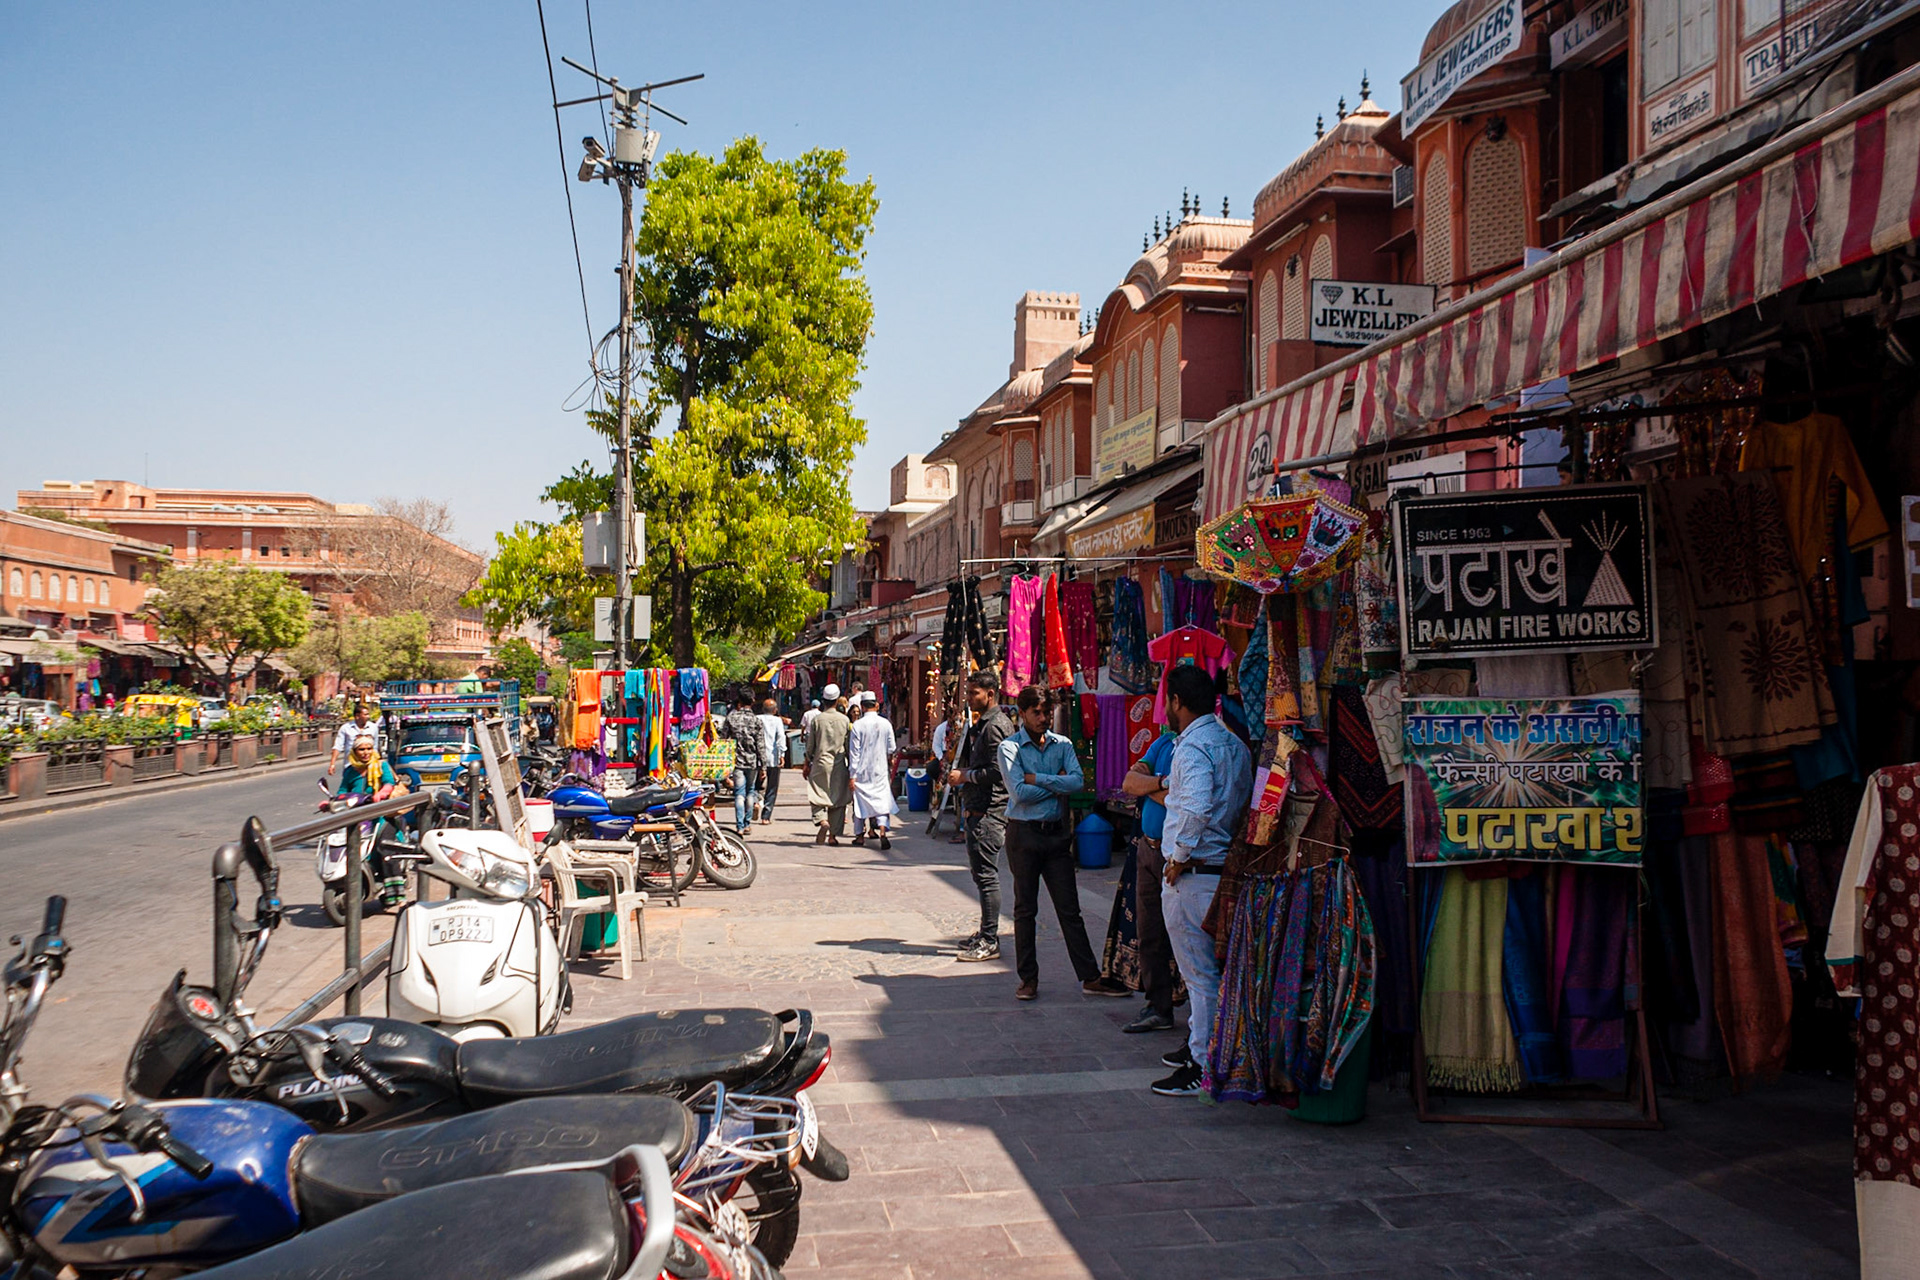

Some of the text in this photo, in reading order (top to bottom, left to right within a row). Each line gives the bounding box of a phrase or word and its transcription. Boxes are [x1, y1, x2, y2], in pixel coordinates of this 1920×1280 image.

[1406, 0, 1515, 111] K.L. JEWELLERS
[1460, 33, 1512, 80] EXPORTERS
[1352, 287, 1393, 306] K.L
[1315, 308, 1428, 330] JEWELLER
[1248, 441, 1268, 481] 29
[1155, 515, 1188, 545] AMOUS
[1416, 528, 1491, 542] SINCE 1963
[1415, 509, 1572, 612] पटाखे
[1418, 610, 1641, 643] RAJAN FIRE WORKS
[1407, 714, 1487, 745] राजन
[1490, 704, 1521, 745] के
[1527, 704, 1621, 744] असली
[1432, 753, 1501, 785] फैन्सी
[1505, 753, 1590, 784] पटाखों
[1594, 752, 1624, 783] के
[1443, 806, 1606, 851] पटाखा
[278, 1074, 363, 1099] PLATIN
